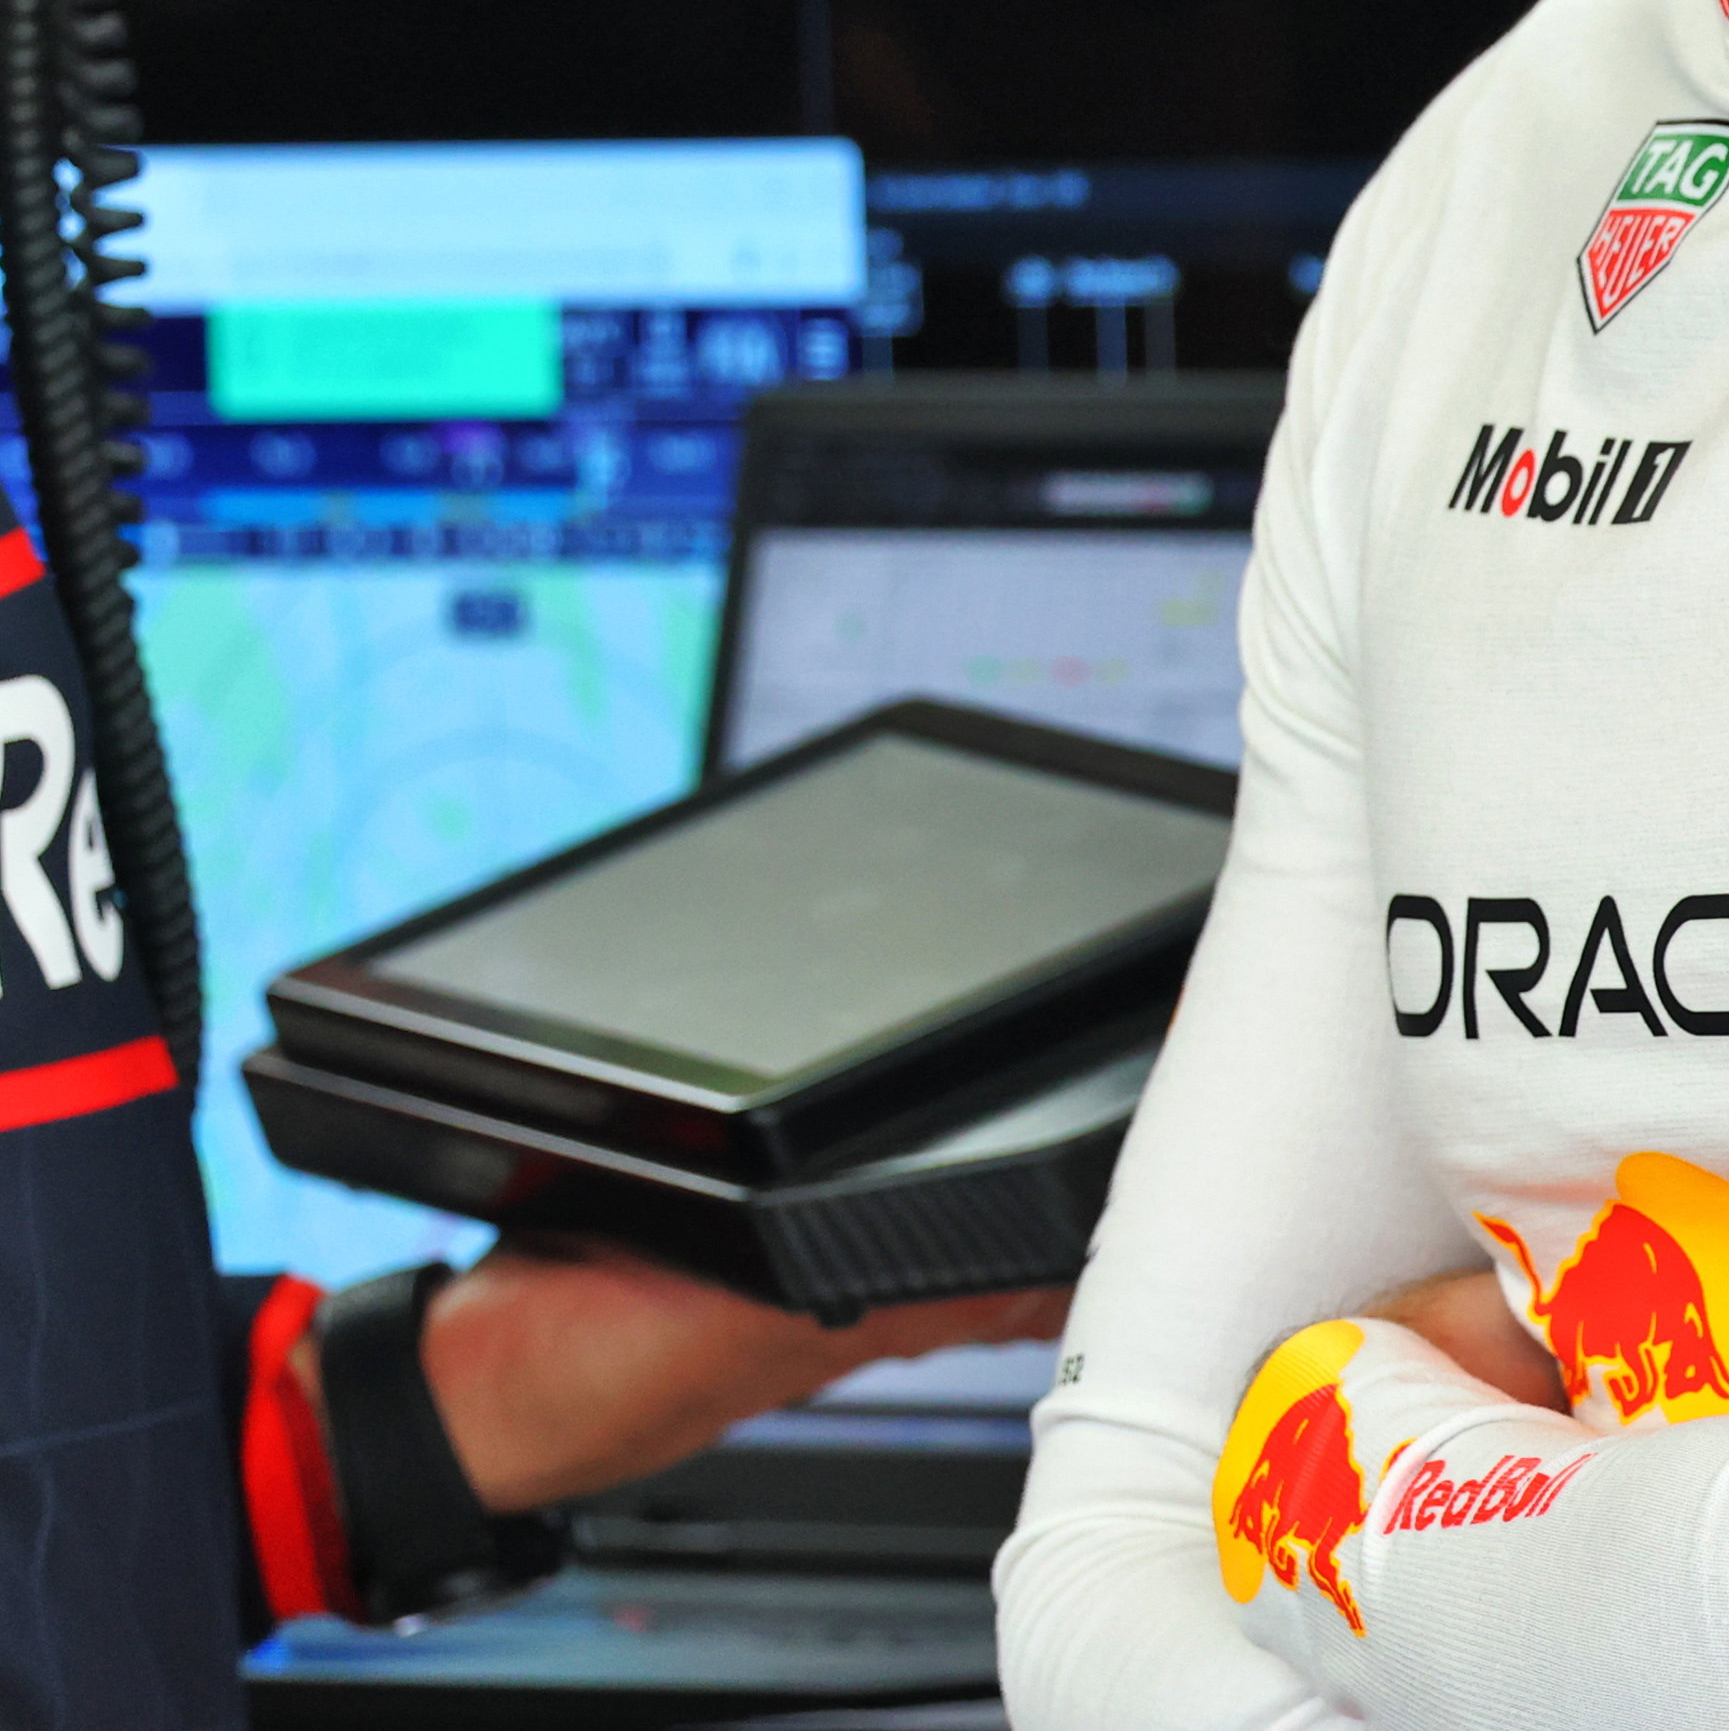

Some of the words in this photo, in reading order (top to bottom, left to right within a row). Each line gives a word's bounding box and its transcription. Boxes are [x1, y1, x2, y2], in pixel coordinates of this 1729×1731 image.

[1632, 140, 1729, 200] TAG
[1589, 214, 1685, 309] HEUER
[1448, 424, 1633, 525] Mobil
[1622, 444, 1685, 523] 1
